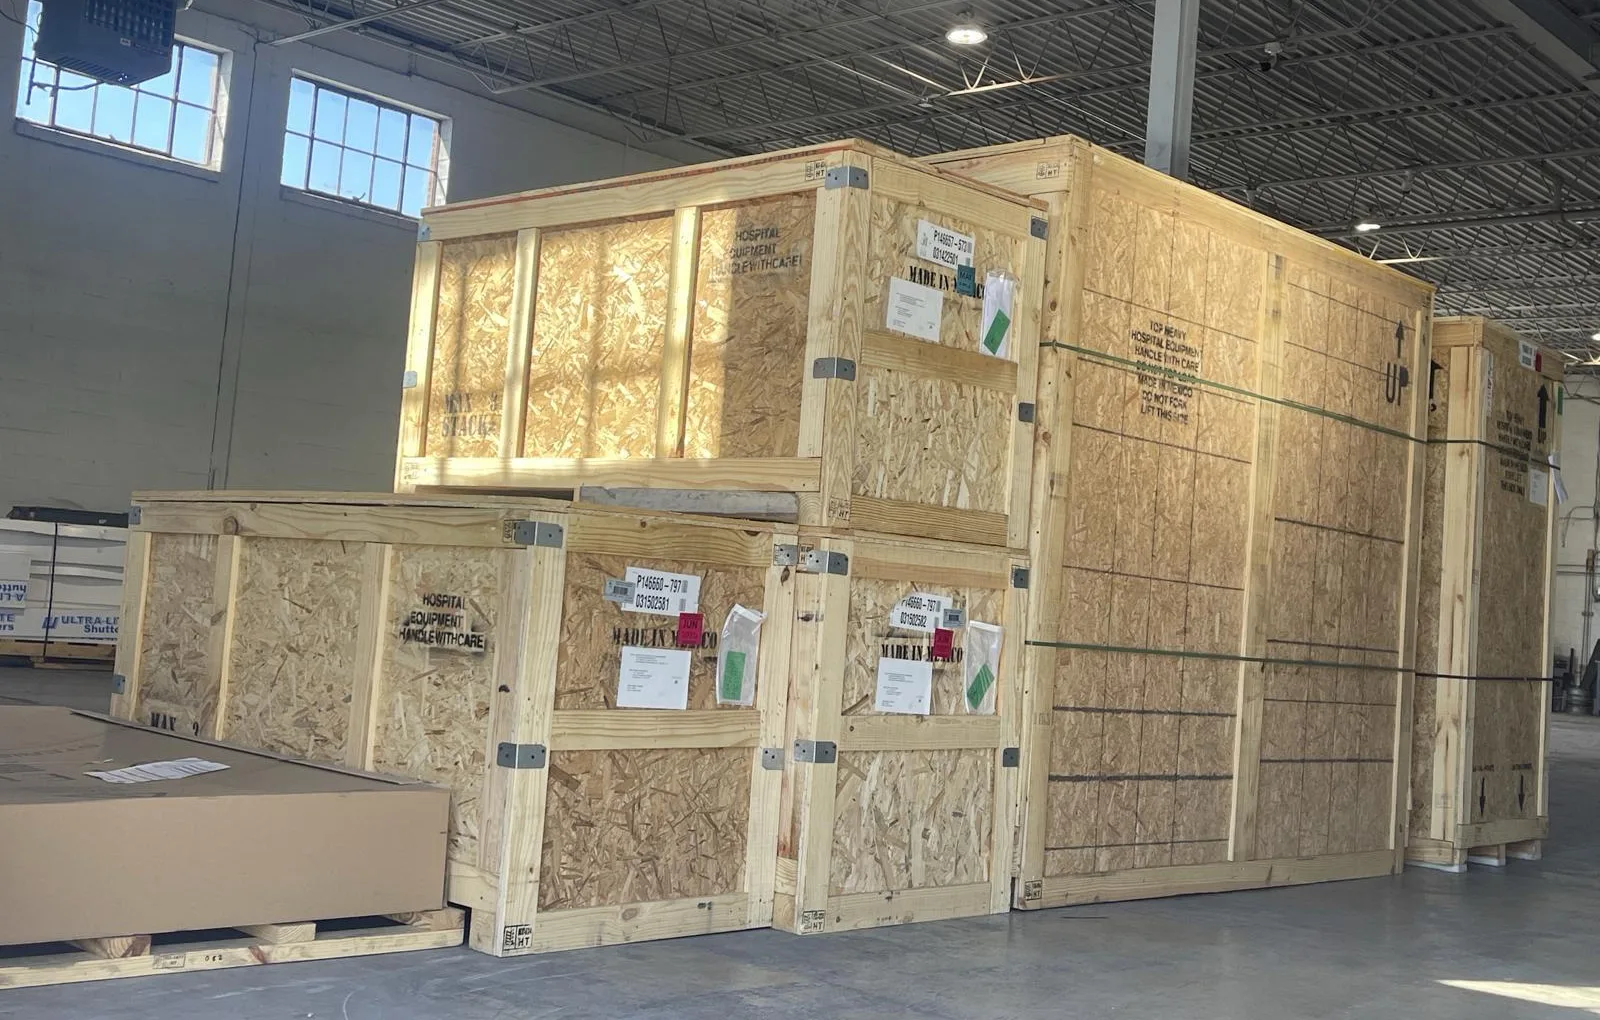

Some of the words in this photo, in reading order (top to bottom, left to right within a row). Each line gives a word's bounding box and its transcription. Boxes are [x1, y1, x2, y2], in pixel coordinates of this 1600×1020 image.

[735, 228, 781, 241] HOSPITAL
[728, 243, 777, 259] QUIPMENT
[907, 265, 937, 289] MADE
[939, 272, 951, 291] IN
[1131, 329, 1164, 348] HOSPITAL
[1135, 346, 1162, 363] HANDLE
[1181, 358, 1200, 373] CARE
[1386, 362, 1409, 406] UP
[1142, 390, 1153, 402] DO
[1154, 392, 1168, 405] NOT
[1156, 406, 1172, 422] THIS
[636, 574, 682, 593] P146660-797
[423, 593, 466, 609] HOSPITAL
[410, 611, 464, 628] EQUIPMENT
[682, 619, 698, 629] JUN
[612, 626, 649, 647] MADE
[651, 629, 667, 647] IN
[671, 630, 718, 649] MCO
[881, 643, 909, 661] MADE
[911, 646, 924, 662] IN
[925, 645, 964, 663] MCO
[518, 937, 531, 947] HT
